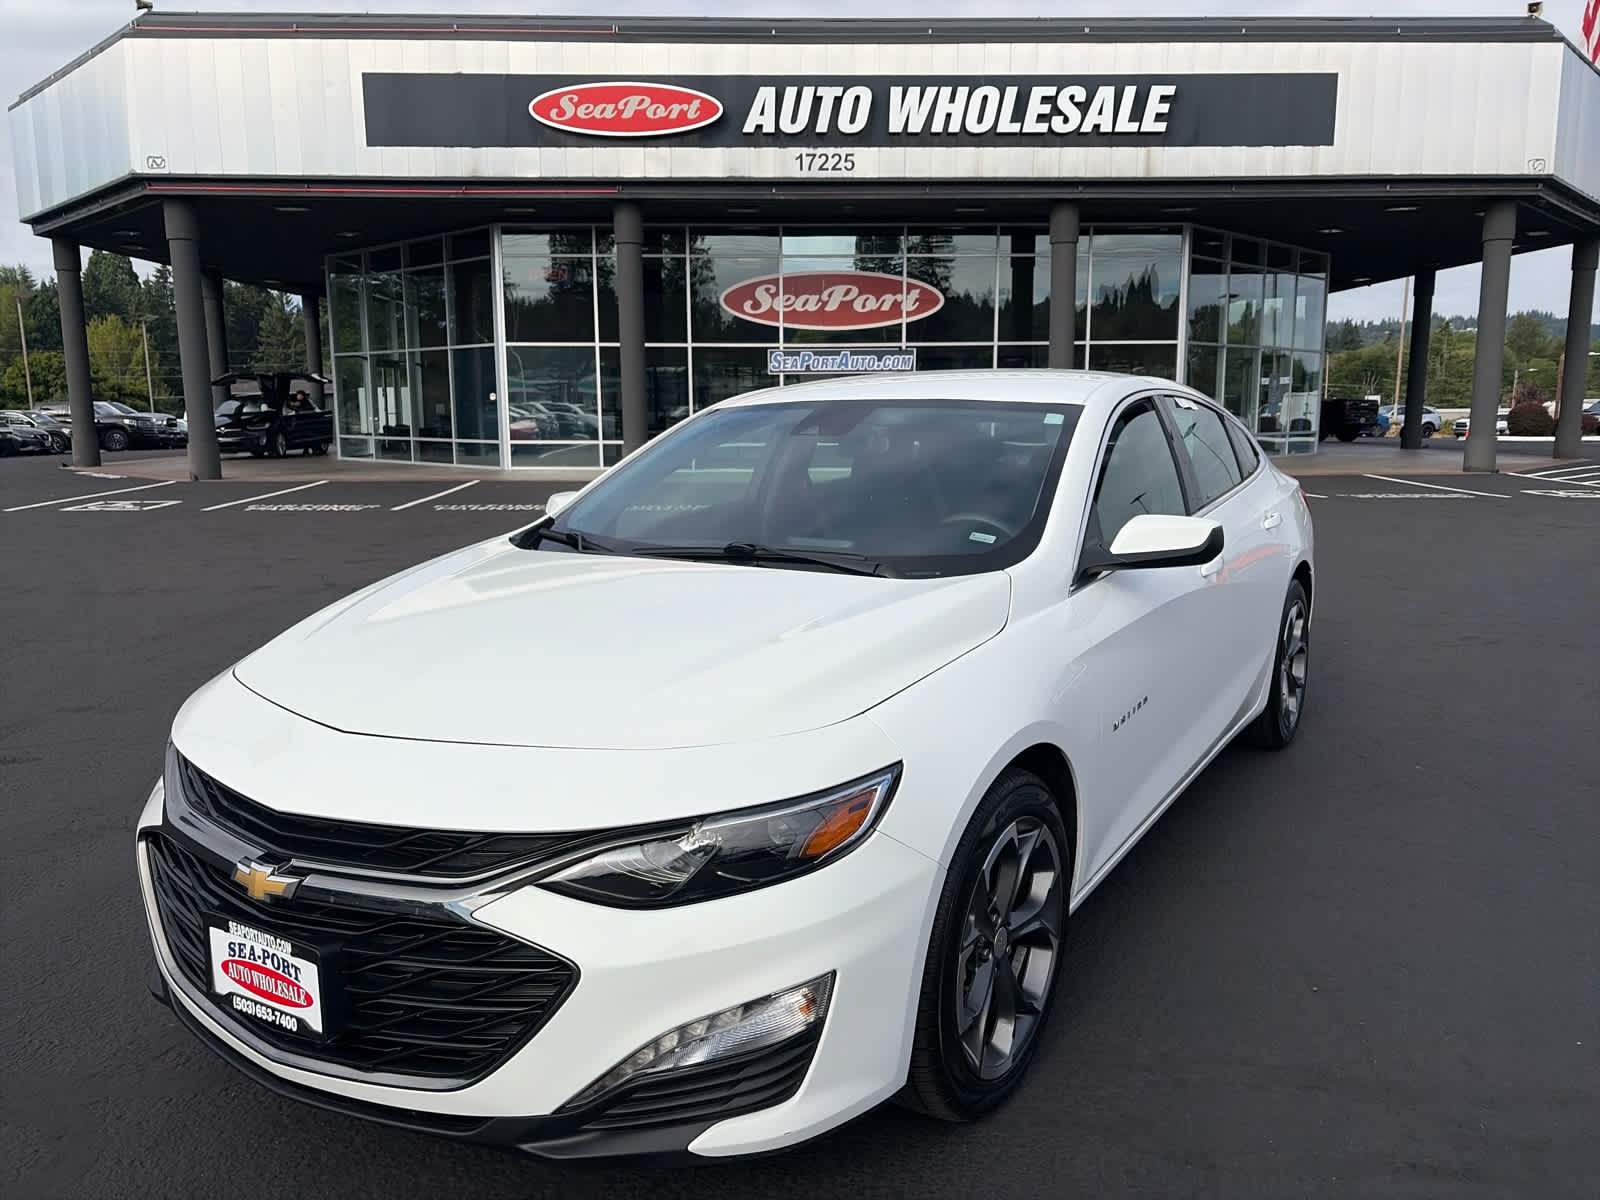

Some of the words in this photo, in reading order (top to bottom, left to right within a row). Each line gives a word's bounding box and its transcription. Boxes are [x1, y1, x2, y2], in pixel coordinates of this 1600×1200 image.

[550, 95, 701, 121] SeaPort
[743, 86, 873, 134] AUTO
[888, 85, 1177, 134] WHOLESALE
[795, 153, 856, 172] 17225
[743, 284, 921, 314] SeaPort
[228, 962, 252, 985] AUTO
[250, 969, 307, 1005] WHOLESALE
